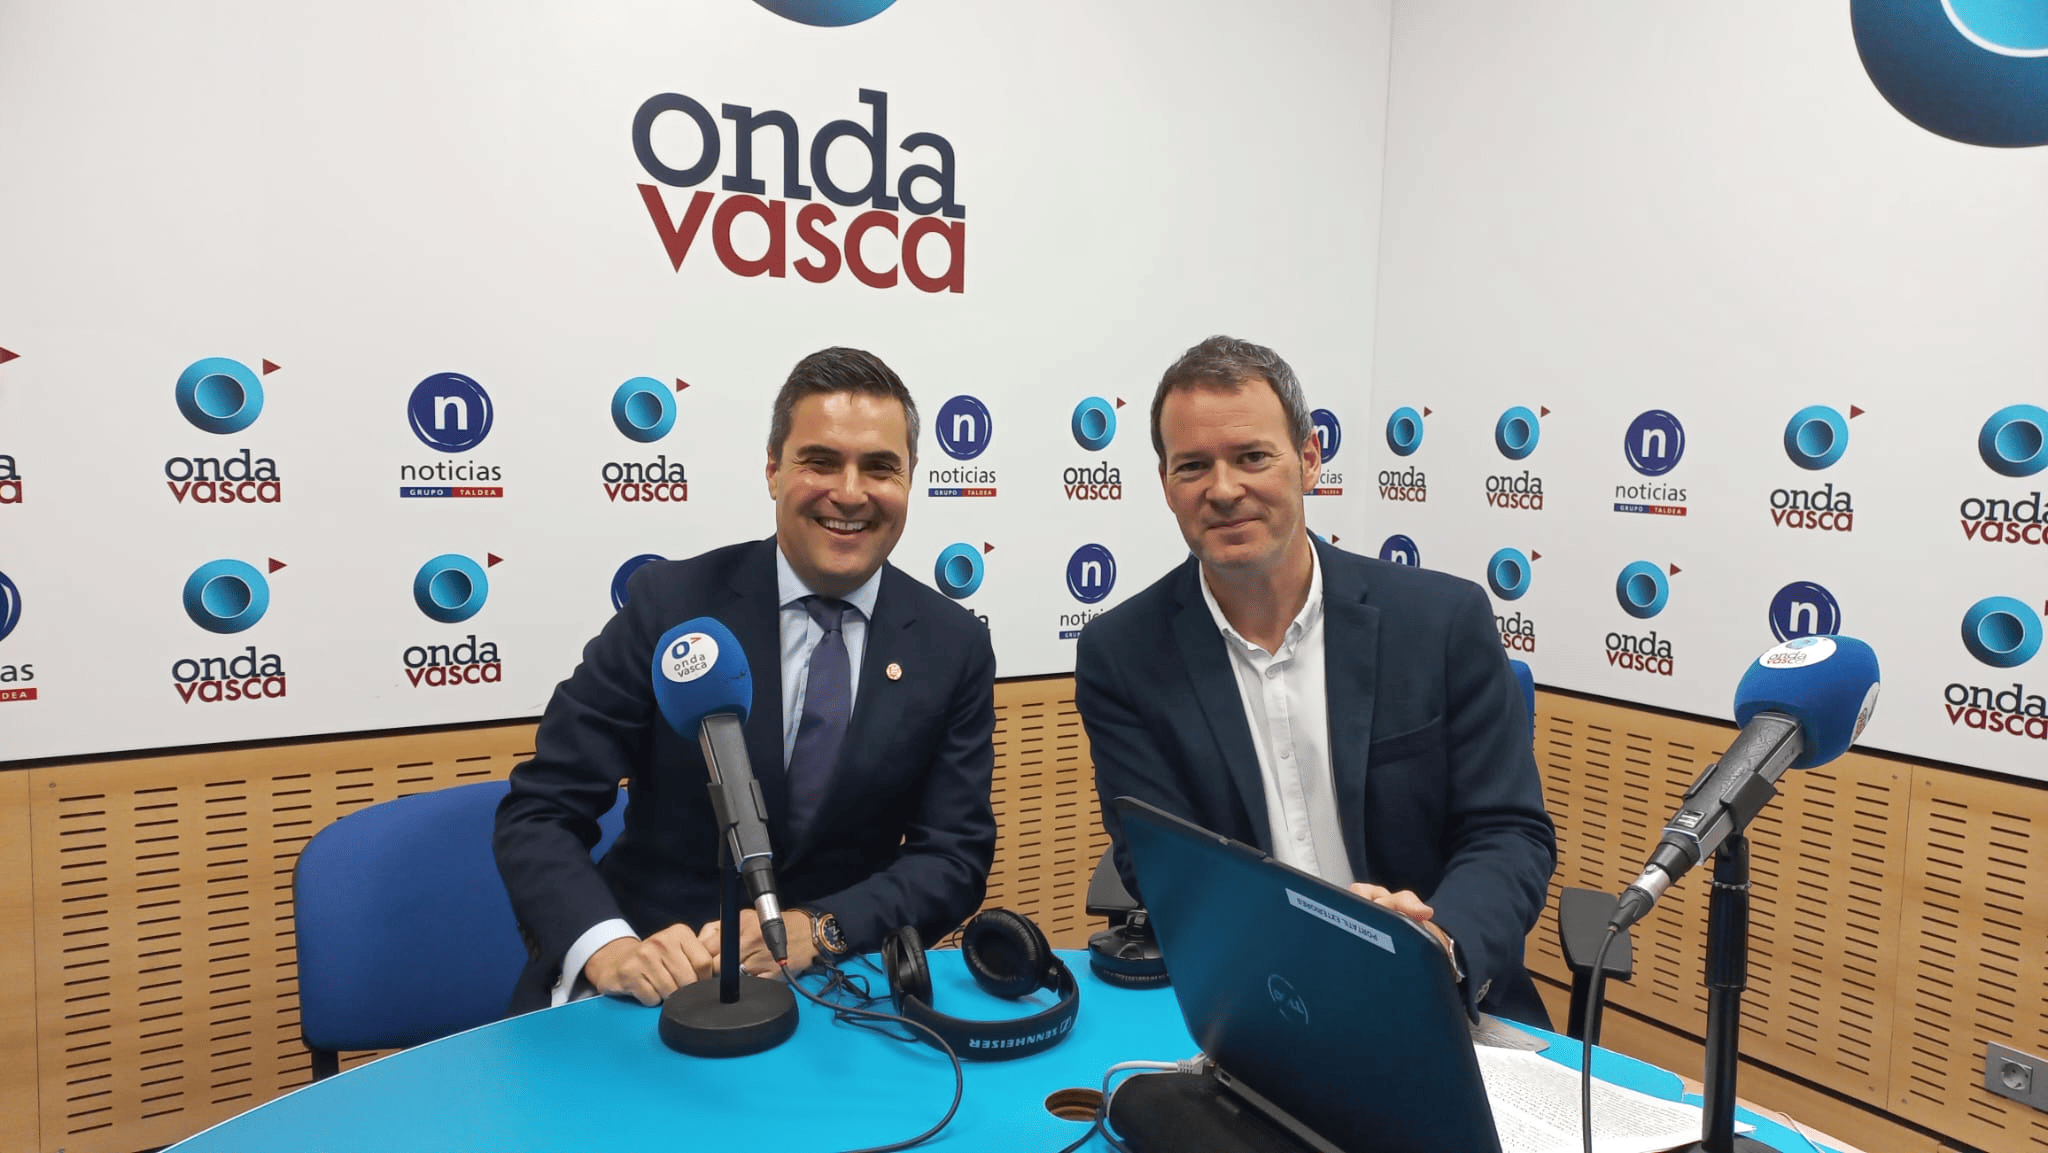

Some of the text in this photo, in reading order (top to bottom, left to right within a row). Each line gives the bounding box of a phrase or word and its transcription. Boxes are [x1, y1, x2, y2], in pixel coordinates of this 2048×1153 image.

[632, 88, 965, 219] onda
[638, 184, 965, 293] vasca
[165, 449, 280, 482] onda
[402, 460, 501, 480] noticias
[602, 455, 687, 483] onda
[930, 467, 995, 483] noticias
[1063, 461, 1121, 484] onda
[1319, 469, 1343, 485] cias
[1379, 466, 1426, 488] onda
[170, 480, 281, 503] vasca
[409, 488, 497, 498] GRUPO TALDEA
[605, 483, 687, 502] vasca
[1064, 483, 1121, 500] vasca
[1379, 485, 1426, 502] vasca
[1486, 470, 1543, 494] onda
[1616, 483, 1686, 501] noticias
[1487, 492, 1543, 510] vasca
[1770, 483, 1853, 513] onda
[1772, 509, 1853, 531] vasca
[1494, 611, 1536, 637] nda
[403, 635, 501, 670] onda
[1502, 633, 1536, 653] sca
[1606, 631, 1673, 659] onda
[172, 646, 285, 683] onda
[673, 654, 706, 671] onda
[677, 661, 708, 678] vasca
[1607, 651, 1673, 675] vasca
[406, 662, 501, 687] vasca
[0, 691, 28, 700] DEA
[175, 676, 286, 703] vasca
[1945, 683, 2048, 719] onda
[1946, 704, 2048, 739] vasca
[968, 1026, 1058, 1049] SENNHEISER
